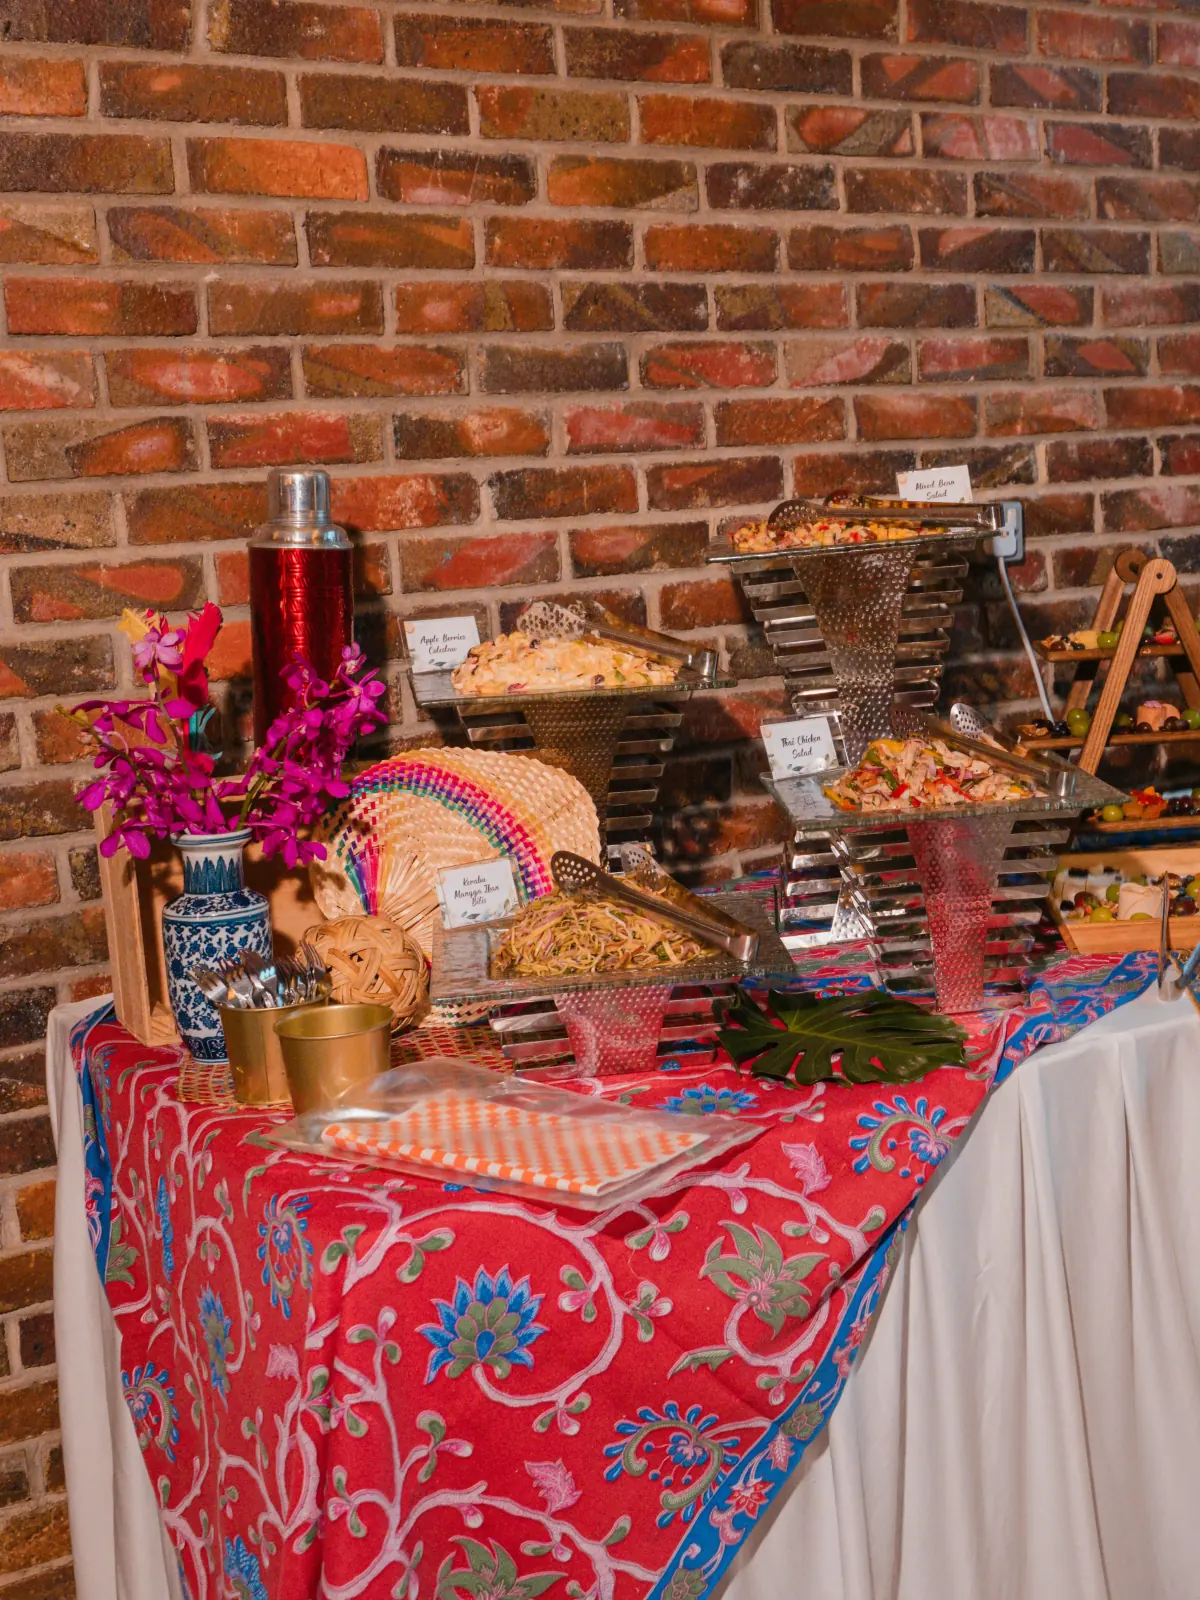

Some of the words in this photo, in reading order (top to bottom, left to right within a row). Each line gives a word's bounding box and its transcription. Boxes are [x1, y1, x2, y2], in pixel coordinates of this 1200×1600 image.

[915, 480, 935, 491] Mixed
[938, 480, 955, 488] Bean
[926, 489, 948, 500] Salad
[420, 635, 440, 646] Apple
[442, 633, 466, 643] Berries
[781, 737, 795, 748] Thai
[797, 733, 821, 746] Chicken
[792, 747, 812, 759] Salad
[463, 875, 486, 886] Kerabu
[454, 889, 482, 900] Mangga
[472, 896, 487, 907] Bilis
